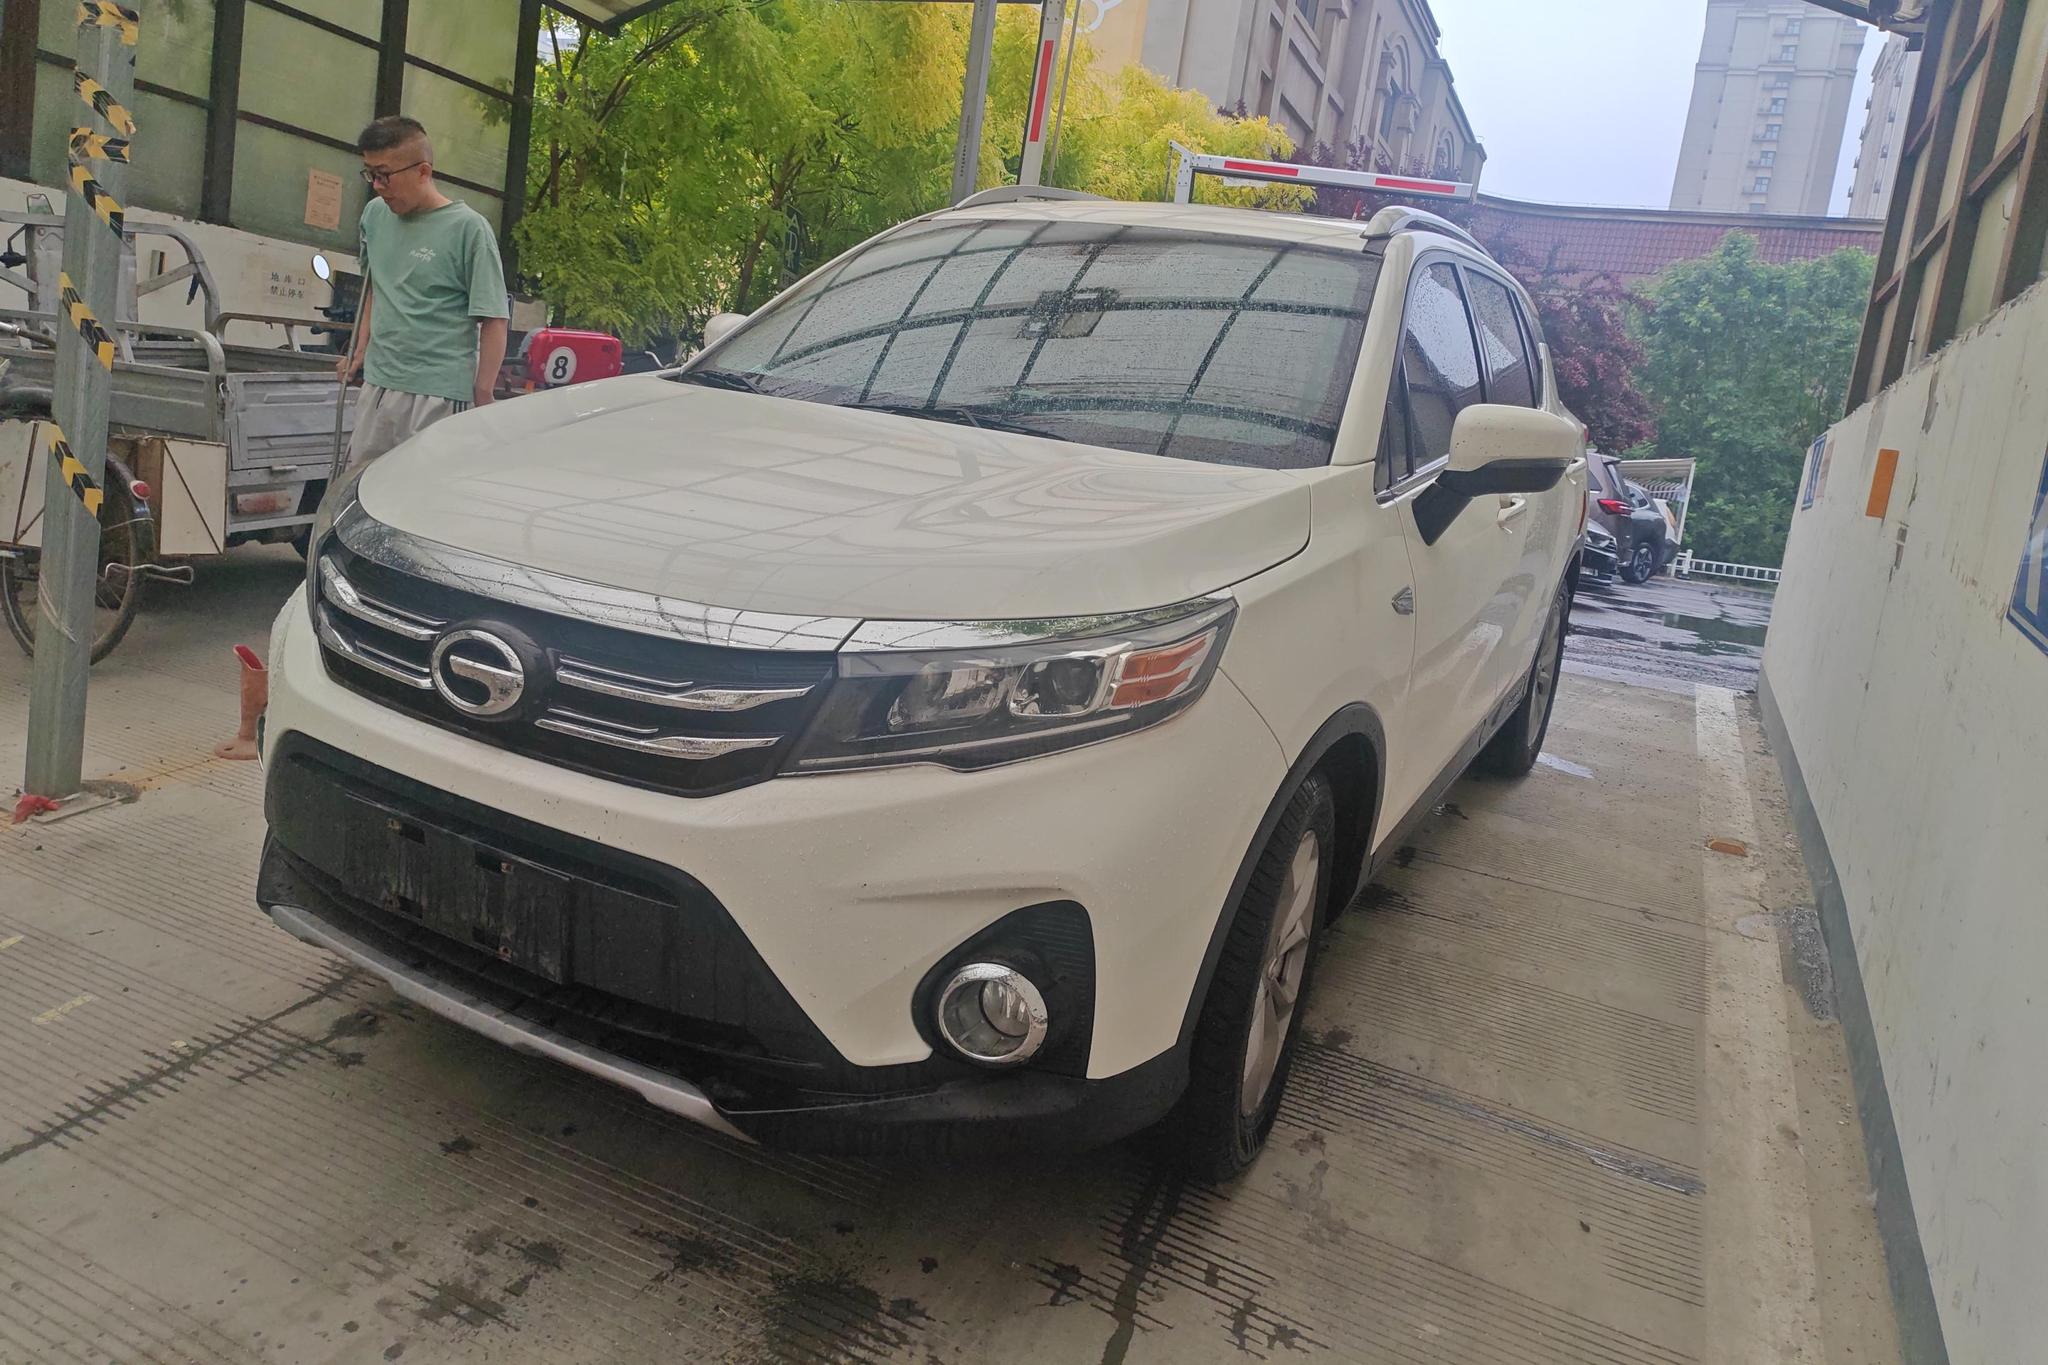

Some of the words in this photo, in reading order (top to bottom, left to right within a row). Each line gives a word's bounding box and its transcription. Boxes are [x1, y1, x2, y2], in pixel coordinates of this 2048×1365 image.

[270, 285, 305, 299] 禁止停车
[552, 355, 569, 380] 8
